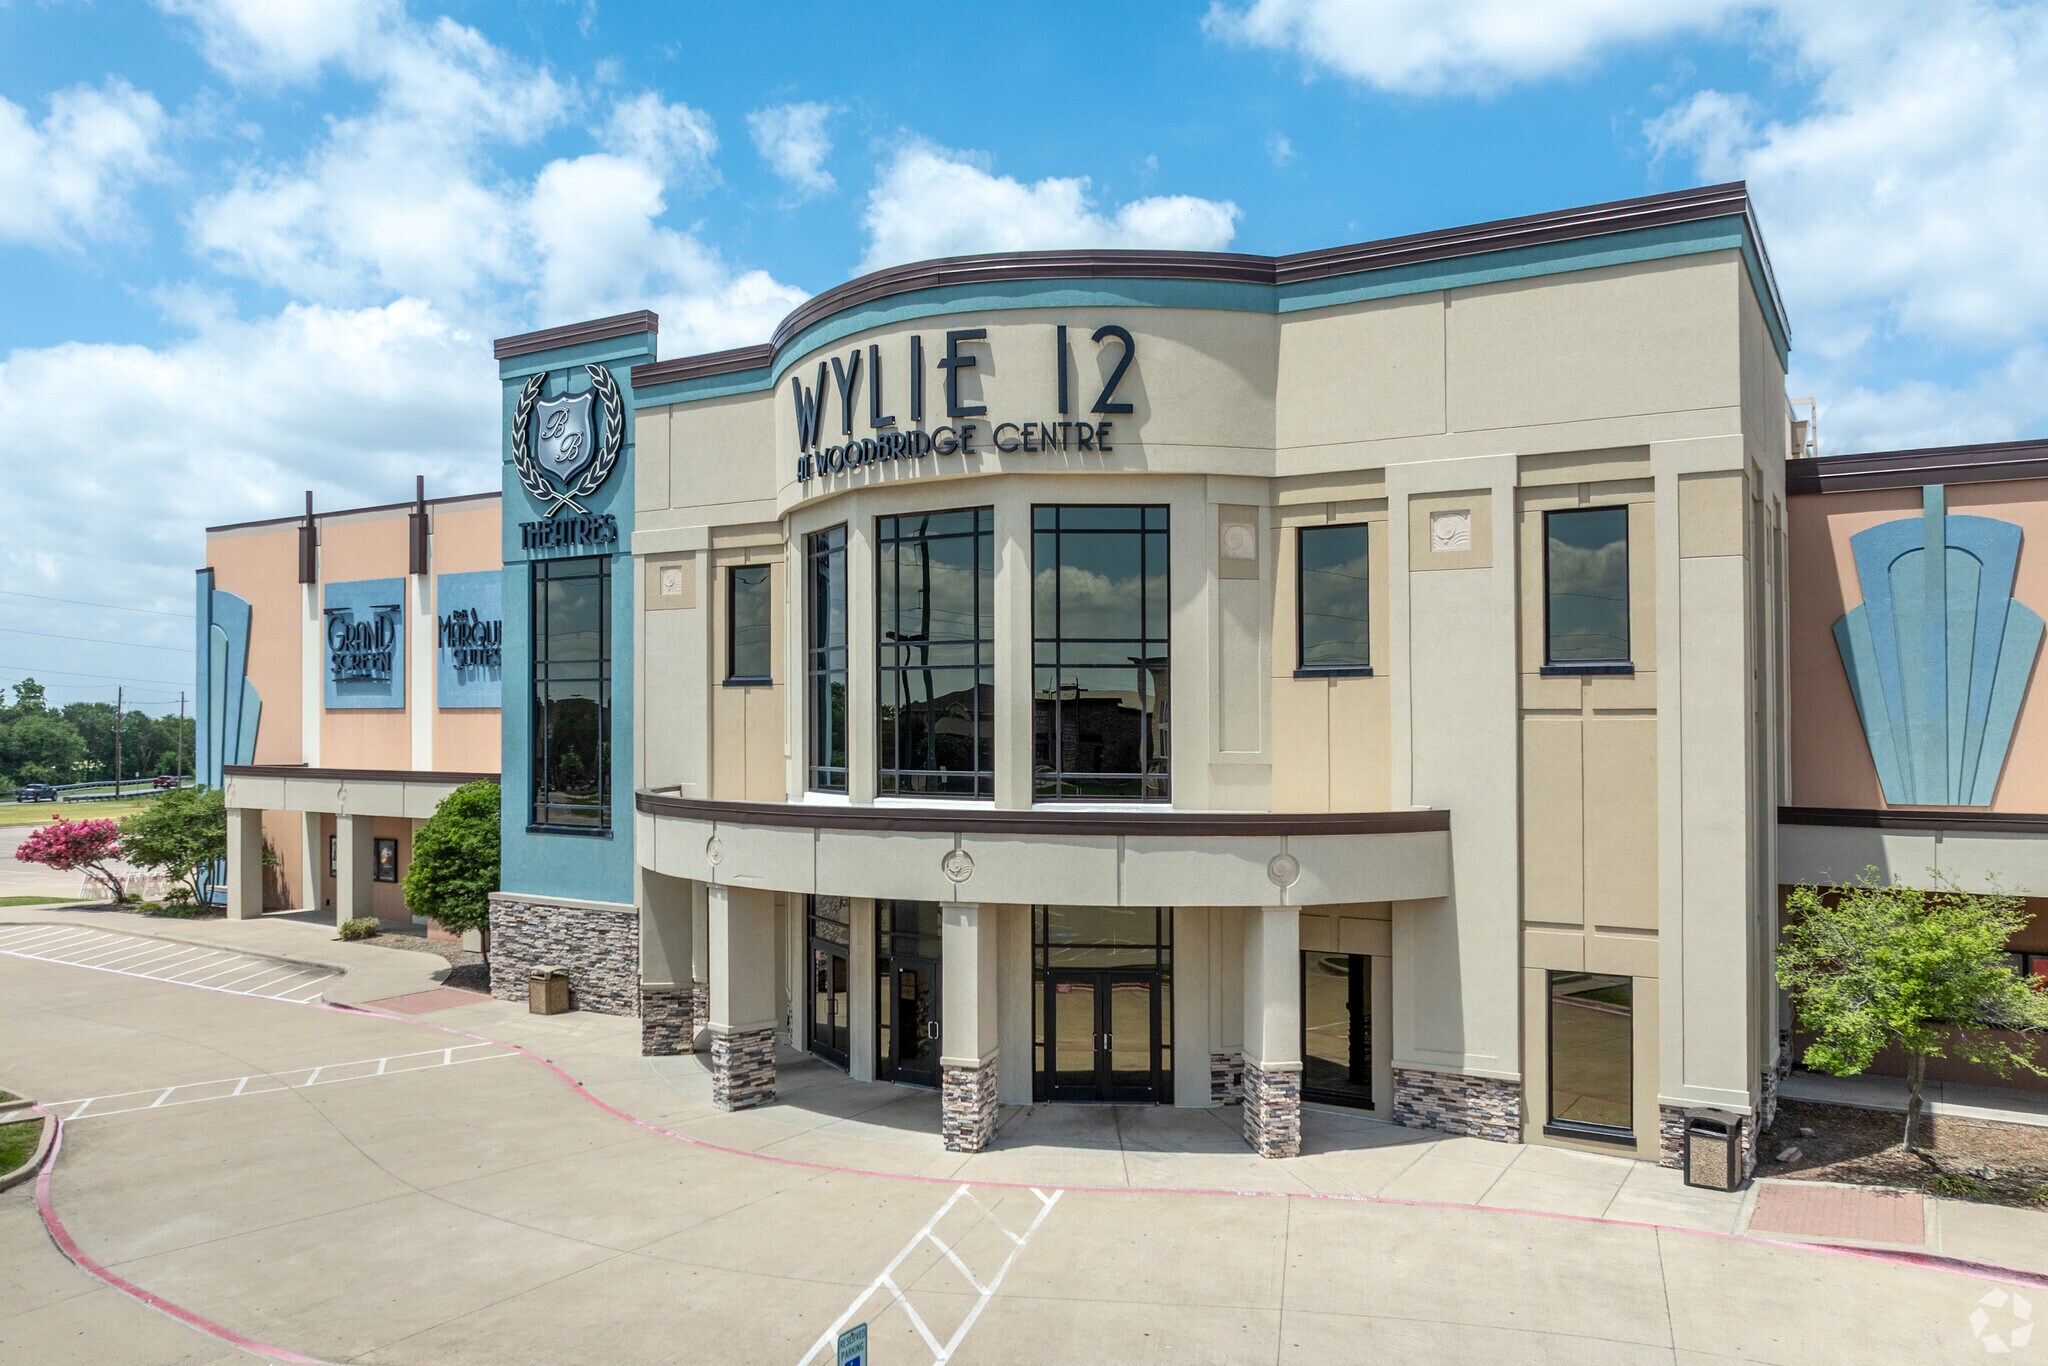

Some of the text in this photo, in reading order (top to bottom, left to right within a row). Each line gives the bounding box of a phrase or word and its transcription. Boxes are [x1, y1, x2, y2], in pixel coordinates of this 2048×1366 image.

[792, 324, 1136, 453] WYLIE 12
[541, 406, 570, 440] B
[555, 430, 584, 463] B
[797, 421, 1113, 483] AT WOODBRIDGE CENTRE
[518, 514, 617, 549] THEATRES
[324, 605, 400, 652] GRAND
[331, 651, 392, 673] SCREEN
[840, 1328, 866, 1348] RESERVED
[841, 1341, 864, 1361] PARKING
